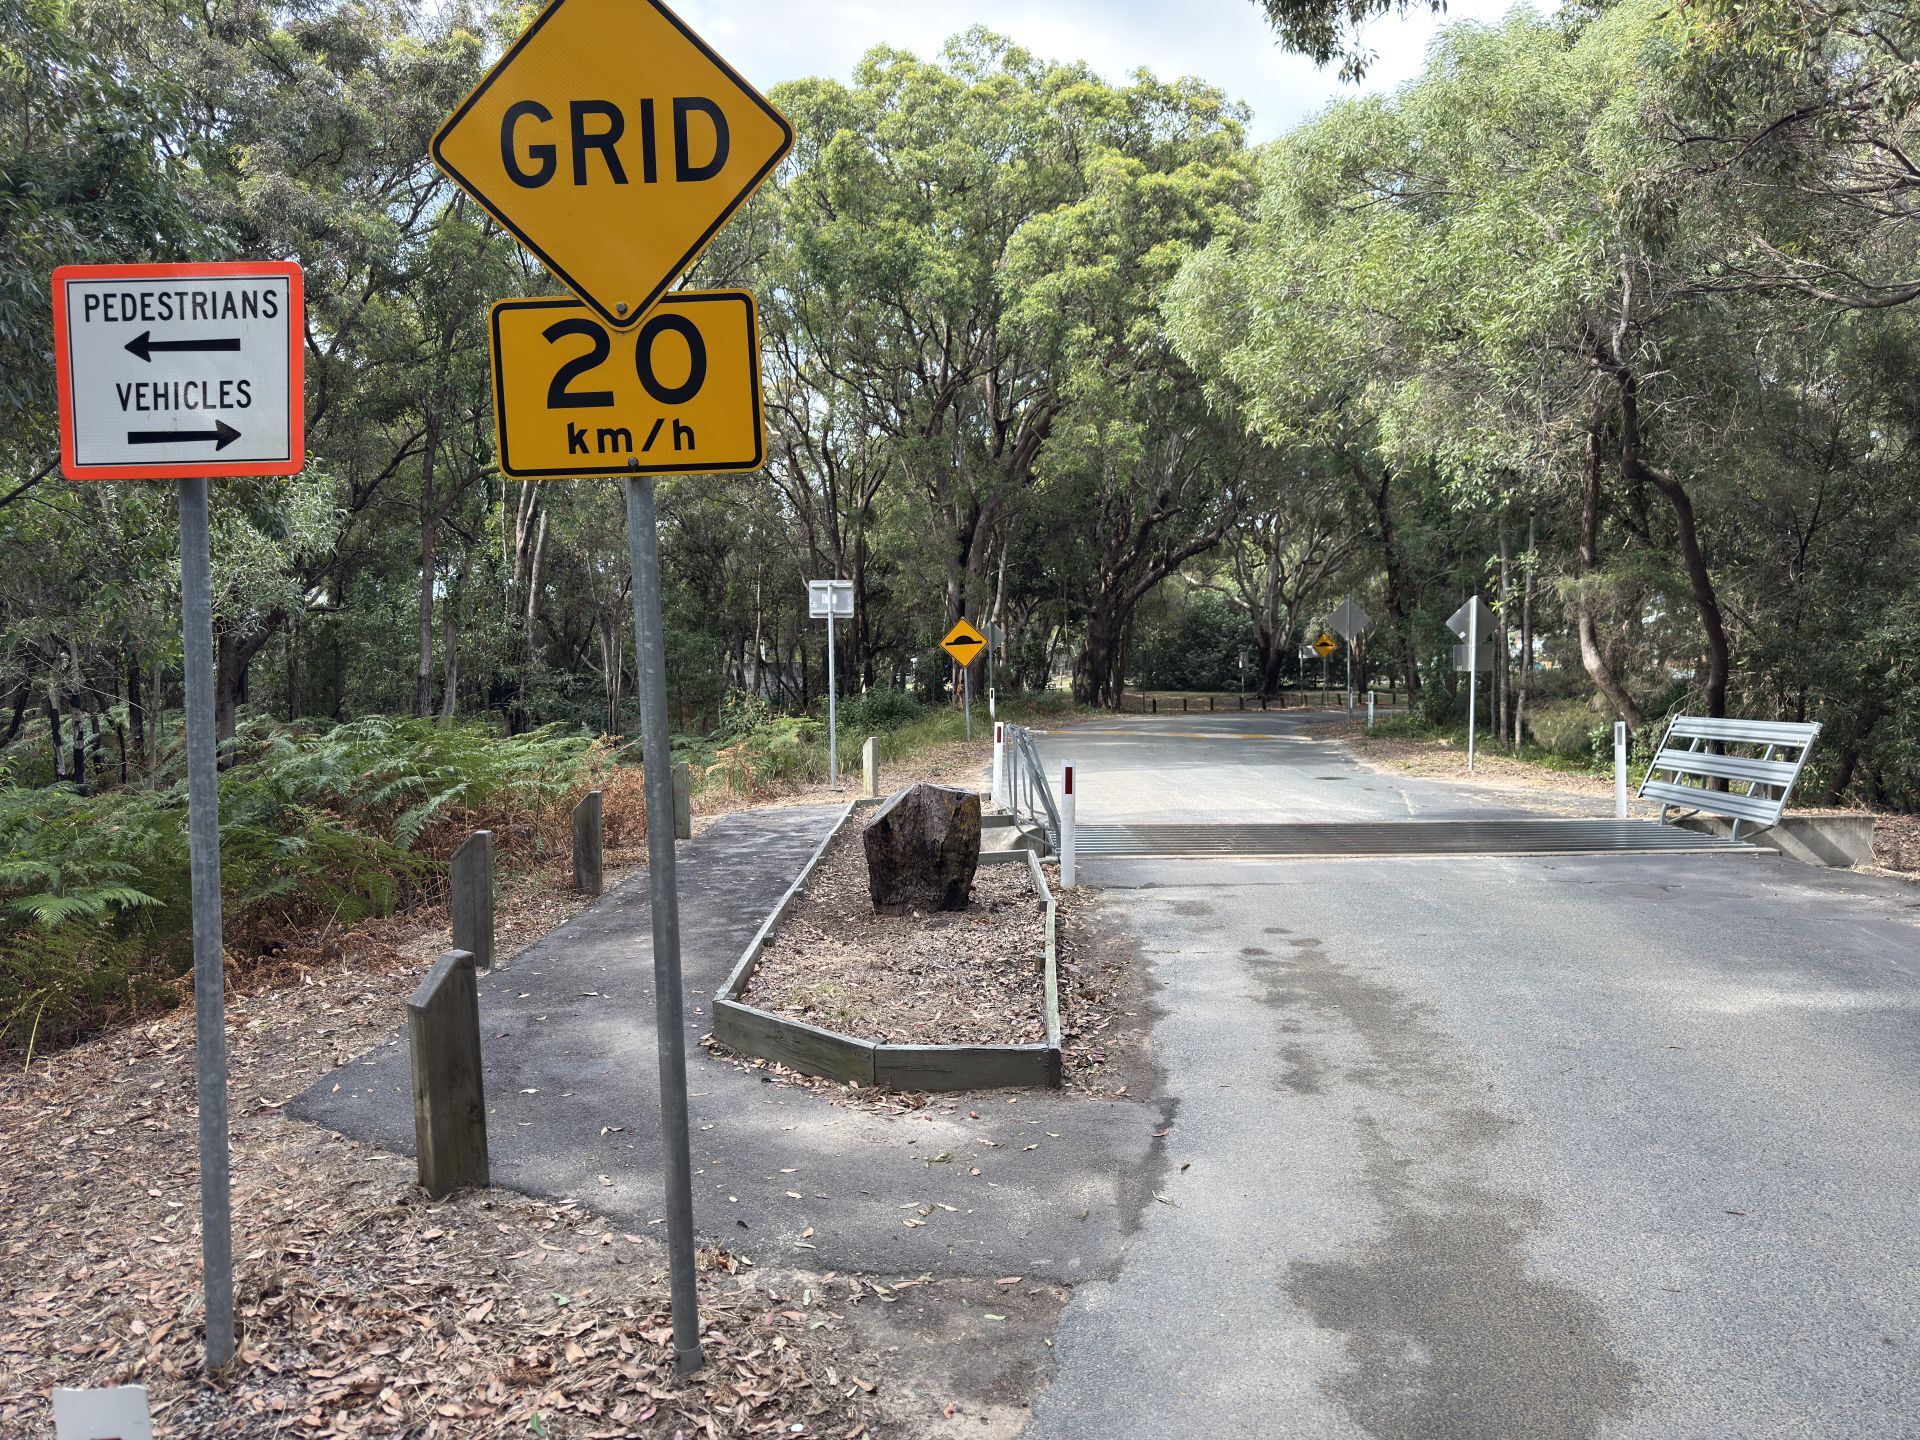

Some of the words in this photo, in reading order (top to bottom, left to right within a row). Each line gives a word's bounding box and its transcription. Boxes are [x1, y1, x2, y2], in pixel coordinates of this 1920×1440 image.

[500, 96, 730, 189] GRID
[84, 289, 279, 323] PEDESTRIANS
[541, 313, 707, 409] 20
[115, 379, 252, 412] VEHICLES
[567, 418, 696, 455] km/h
